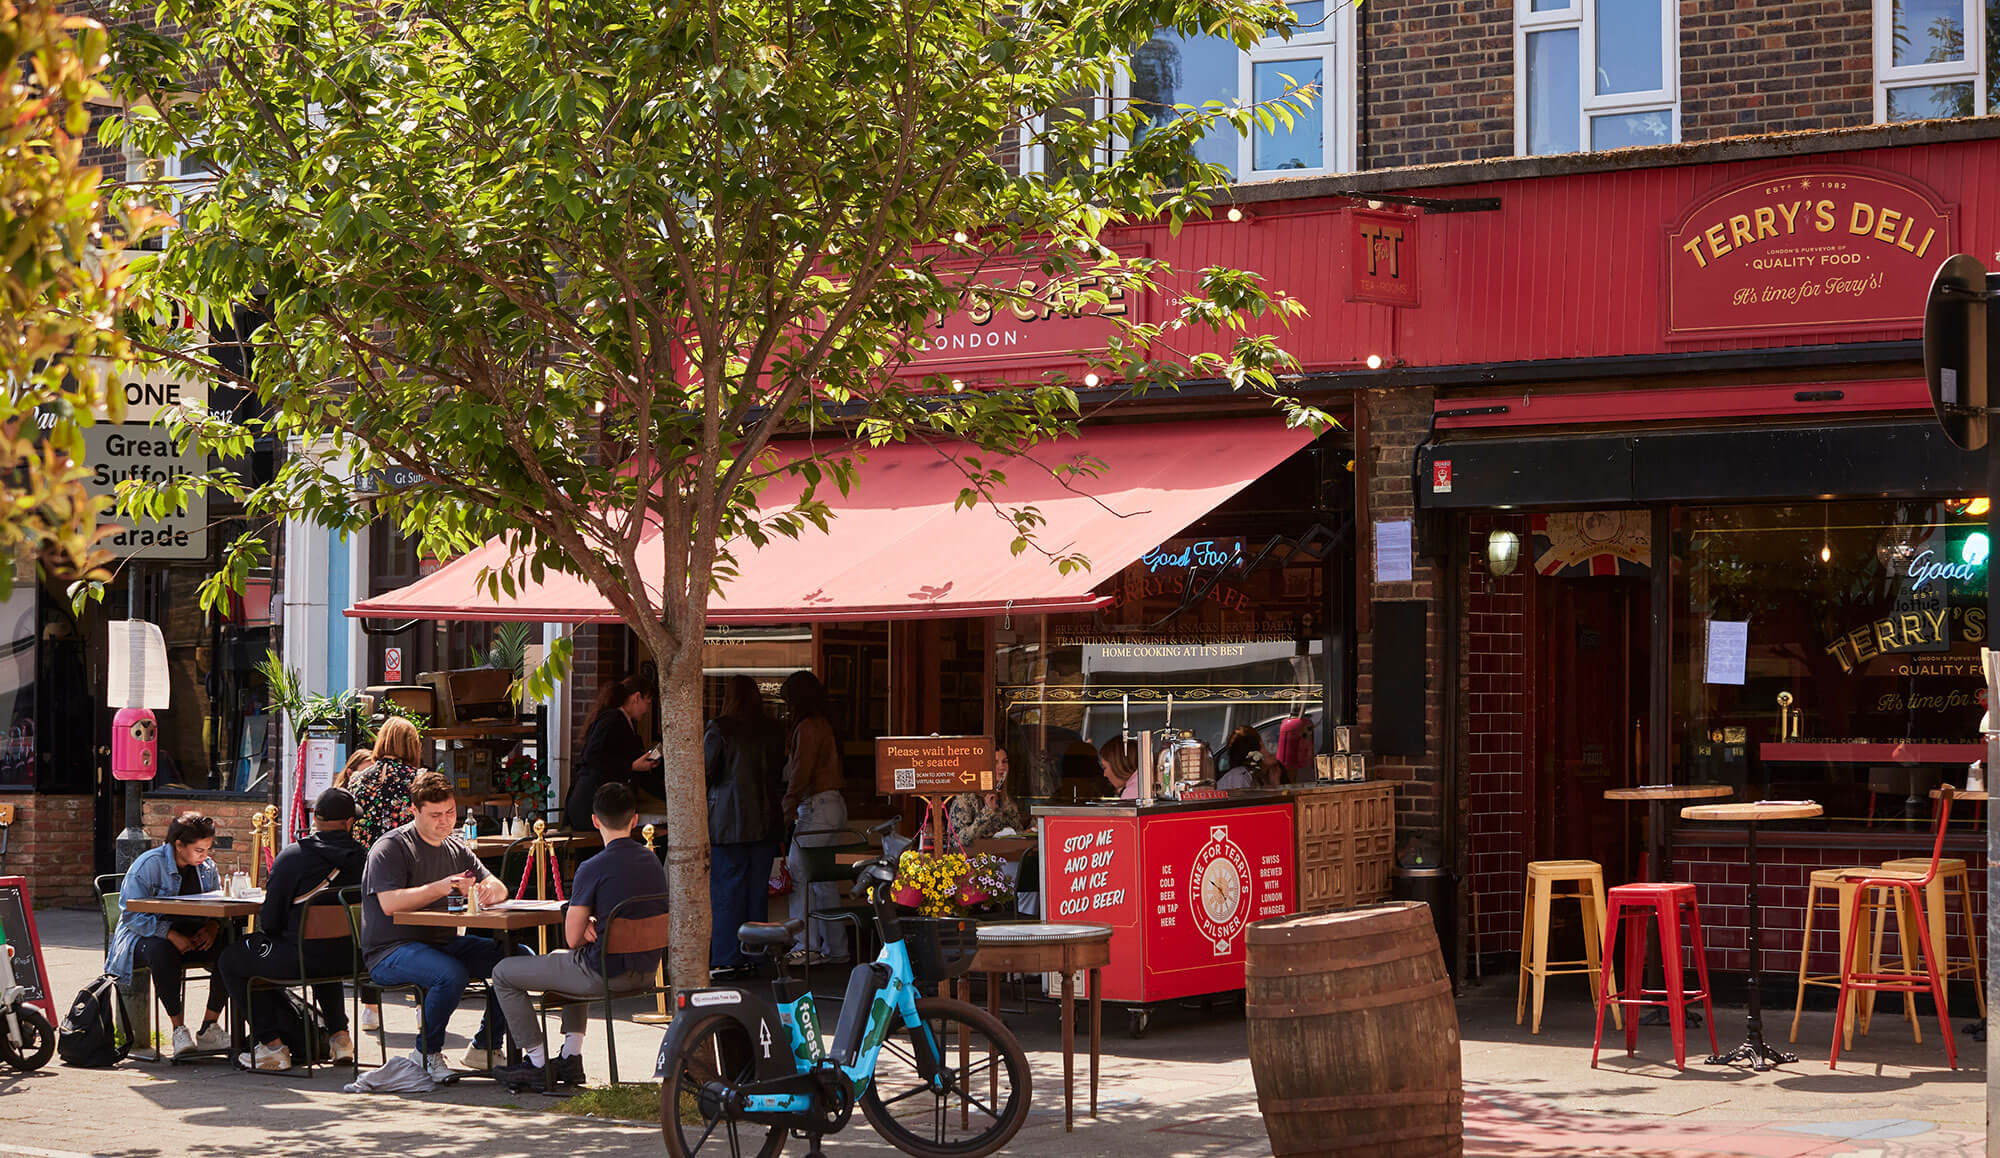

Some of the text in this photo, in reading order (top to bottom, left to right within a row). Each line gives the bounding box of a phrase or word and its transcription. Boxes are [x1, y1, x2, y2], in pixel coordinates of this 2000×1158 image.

[1821, 181, 1847, 190] 1982
[1683, 199, 1936, 268] TERRY'S DELI
[1752, 253, 1861, 270] QUALITY FOOD
[1732, 272, 1885, 306] It's time for Terry's!
[921, 330, 1018, 351] LONDON
[122, 382, 181, 406] ONE
[105, 433, 181, 458] Great
[395, 472, 406, 484] Gt
[95, 524, 189, 547] arade
[1141, 545, 1191, 573] Good
[1908, 549, 1976, 591] Good
[718, 624, 730, 635] TO
[1055, 635, 1123, 647] TRADITIONAL
[1125, 634, 1167, 646] ENGLISH
[1169, 635, 1178, 645] &
[1824, 607, 1986, 674] TERRY'S
[1102, 645, 1245, 658] HOME COOKING AT IT'S BEST
[1898, 664, 1964, 676] QUALITY
[1907, 692, 1944, 710] time
[888, 745, 984, 757] Please wait here to
[911, 756, 960, 768] be seated
[1063, 828, 1115, 854] STOP ME
[1063, 850, 1115, 875] AND BUY
[1261, 854, 1281, 865] SWISS
[1162, 865, 1173, 875] ICE
[1192, 843, 1250, 901] TIME FOR TERRY'S
[1259, 866, 1283, 877] BREWED
[1070, 870, 1109, 893] AN ICE
[1159, 878, 1175, 889] COLD
[1264, 879, 1280, 890] WITH
[1059, 888, 1126, 917] COLD BEER!
[1159, 891, 1176, 901] BEER
[1260, 892, 1284, 904] LONDON
[1157, 903, 1179, 915] ON TAP
[1259, 904, 1286, 916] SWAGGER
[1160, 917, 1176, 928] HERE
[1203, 915, 1242, 938] PILSNER
[799, 1001, 822, 1060] forest
